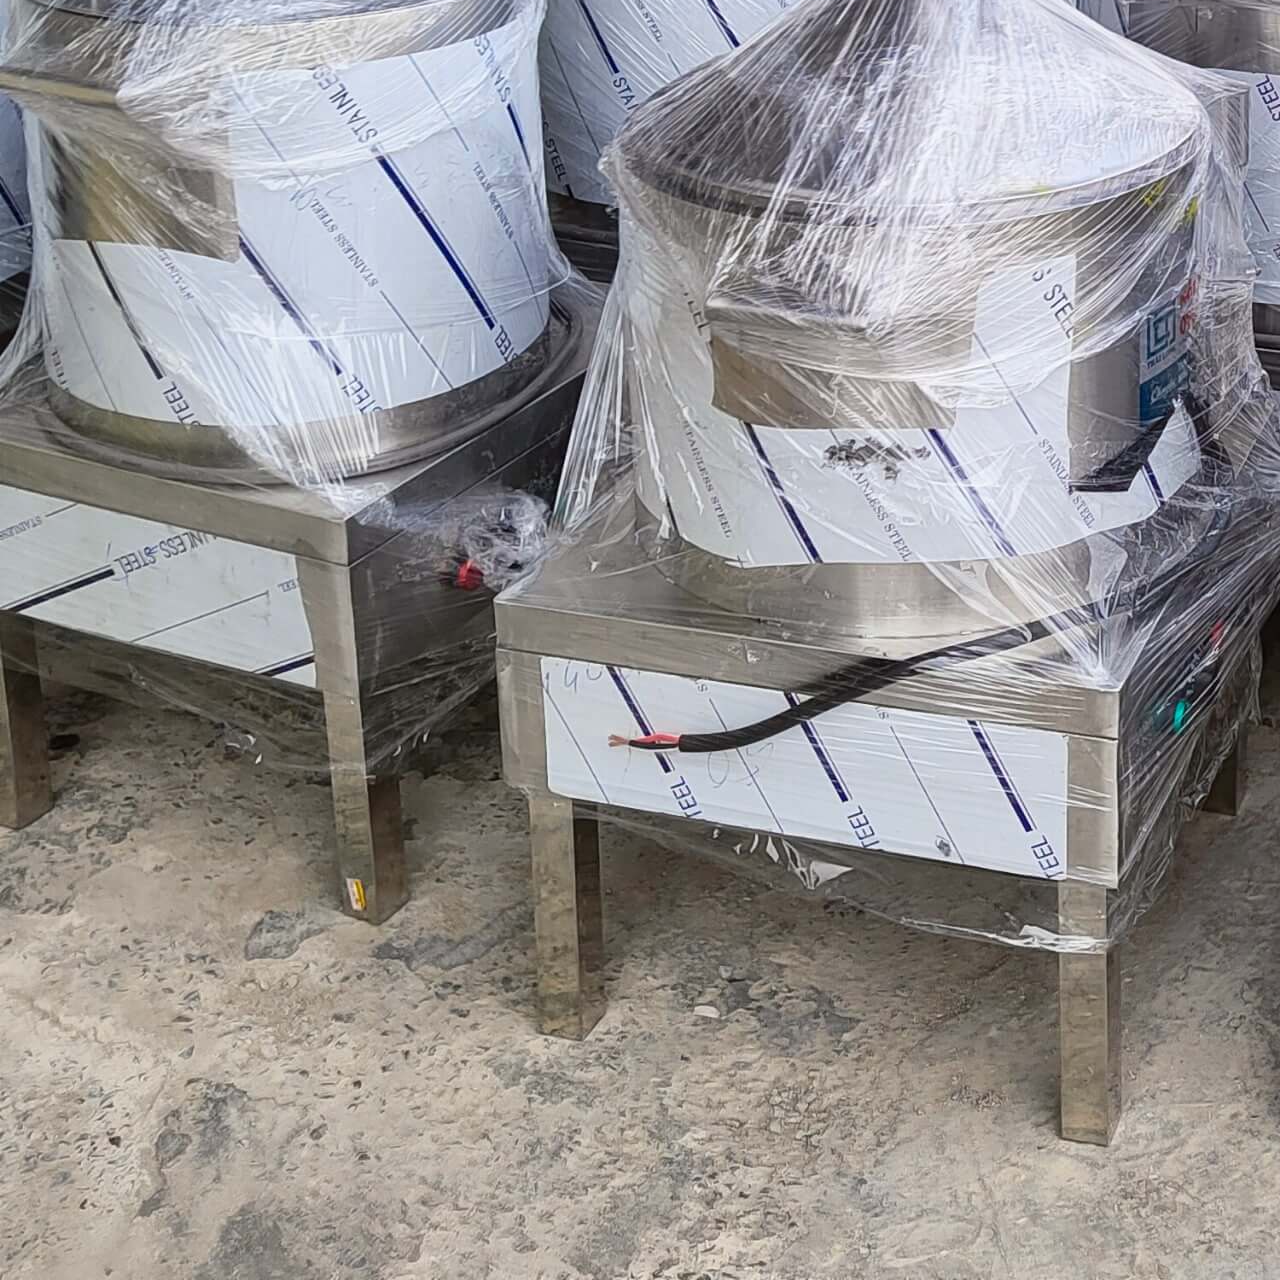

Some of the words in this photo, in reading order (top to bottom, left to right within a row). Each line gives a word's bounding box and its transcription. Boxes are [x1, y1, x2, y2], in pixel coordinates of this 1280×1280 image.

[310, 198, 338, 234] STEEL
[334, 232, 380, 288] STAINLESS
[710, 495, 735, 539] STEEL
[1072, 495, 1096, 529] STEEL
[885, 521, 913, 562] STEEL
[669, 775, 702, 818] TEEL
[847, 805, 880, 848] TEEL
[1031, 835, 1063, 878] TEEL
